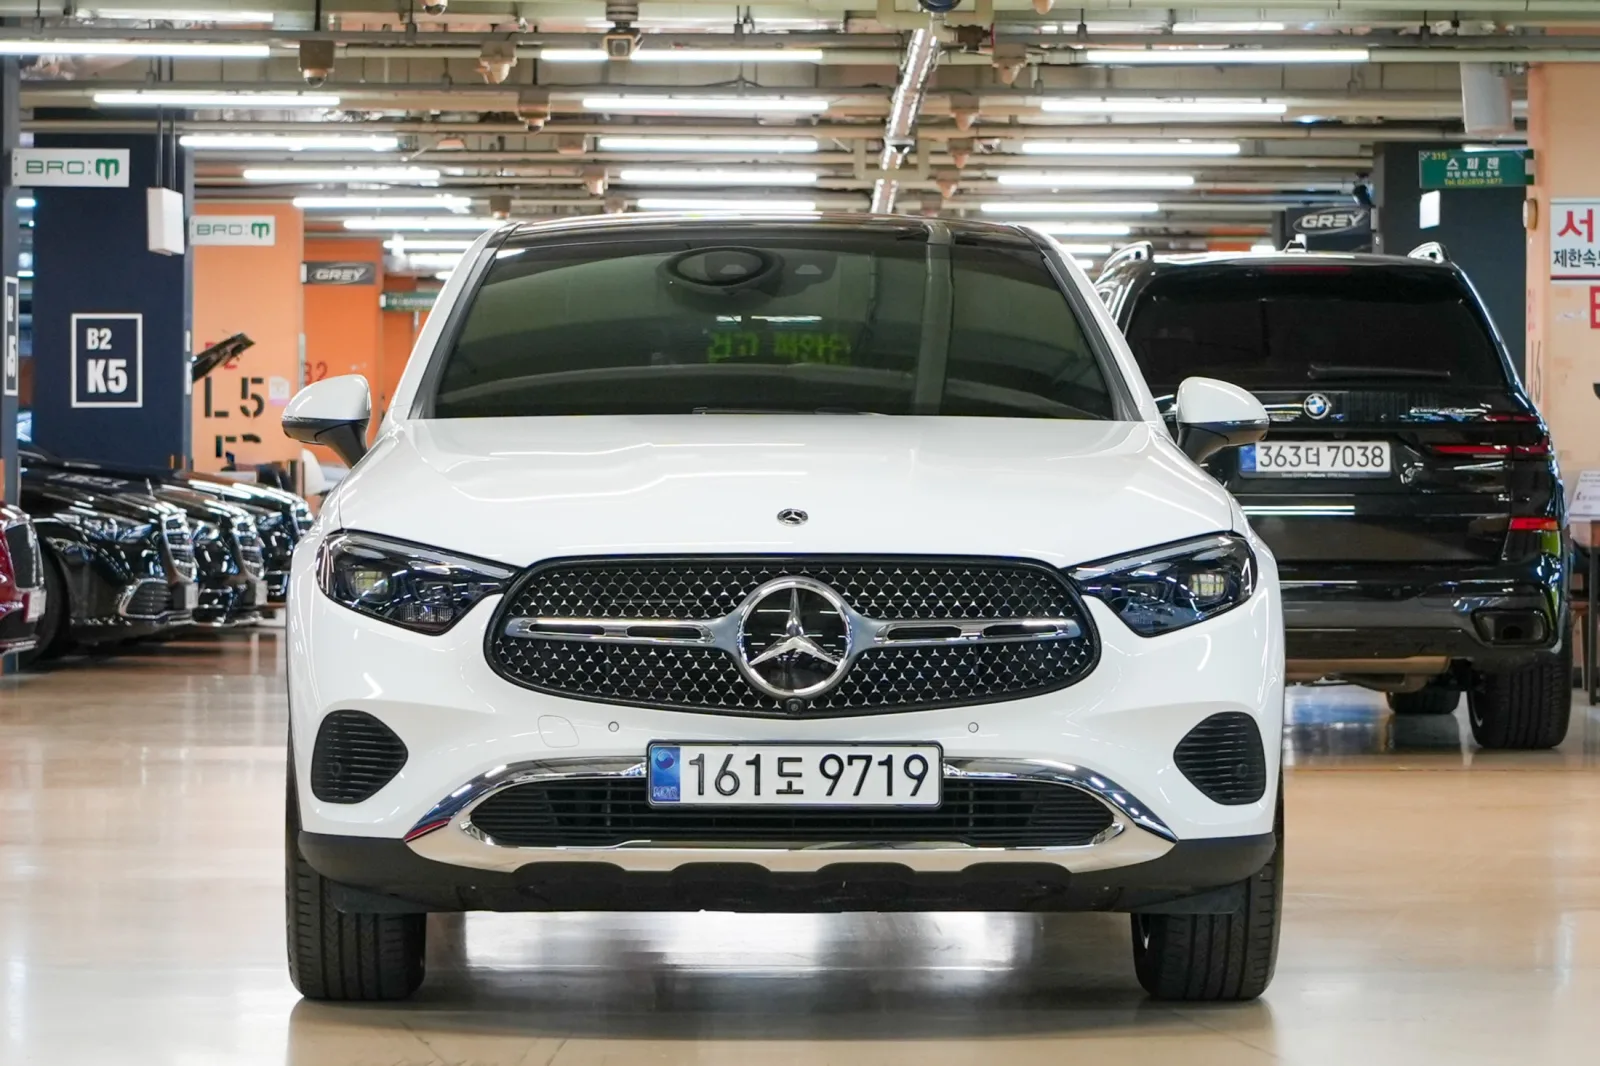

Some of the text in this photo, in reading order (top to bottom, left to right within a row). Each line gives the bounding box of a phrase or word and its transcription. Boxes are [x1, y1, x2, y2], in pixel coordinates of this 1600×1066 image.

[1301, 209, 1365, 228] GREY
[1557, 208, 1594, 243] 서
[316, 268, 367, 281] GREY
[86, 327, 113, 350] B2
[87, 358, 128, 394] K5
